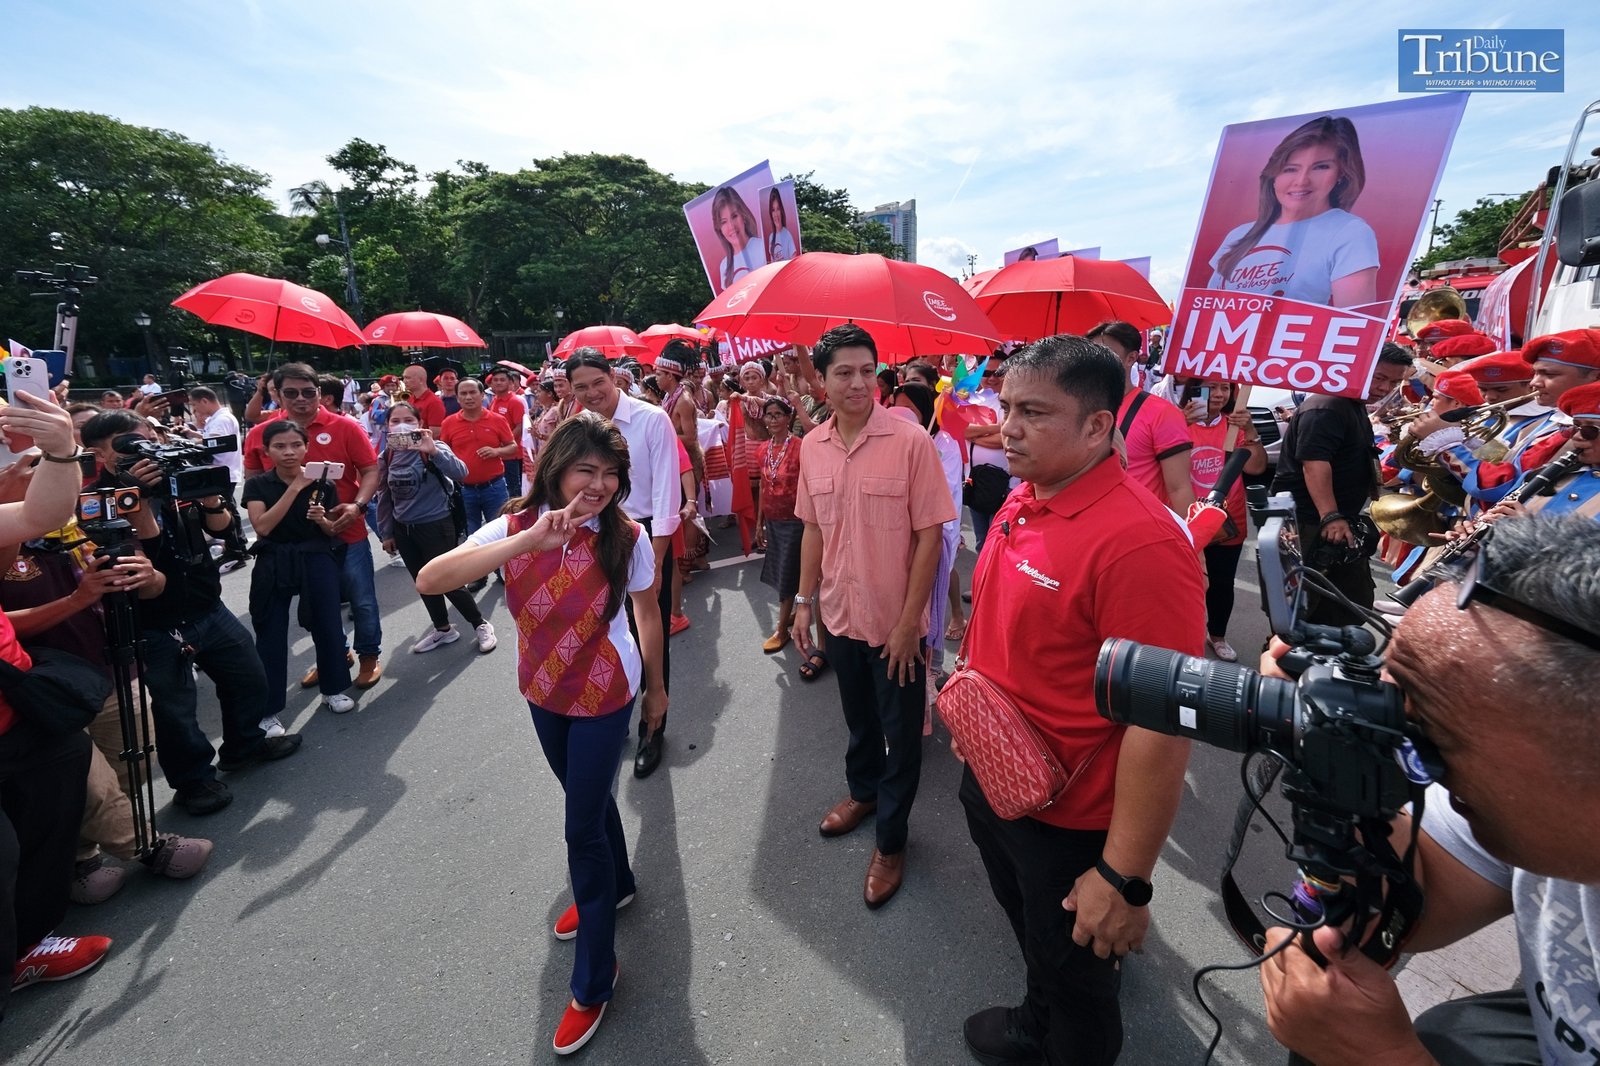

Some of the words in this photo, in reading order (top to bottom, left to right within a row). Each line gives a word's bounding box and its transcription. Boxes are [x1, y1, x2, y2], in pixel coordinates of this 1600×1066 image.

[1229, 260, 1284, 284] IMEE
[1192, 296, 1274, 312] SENATOR
[1181, 310, 1369, 364] IMEE
[1174, 349, 1351, 393] MARCOS
